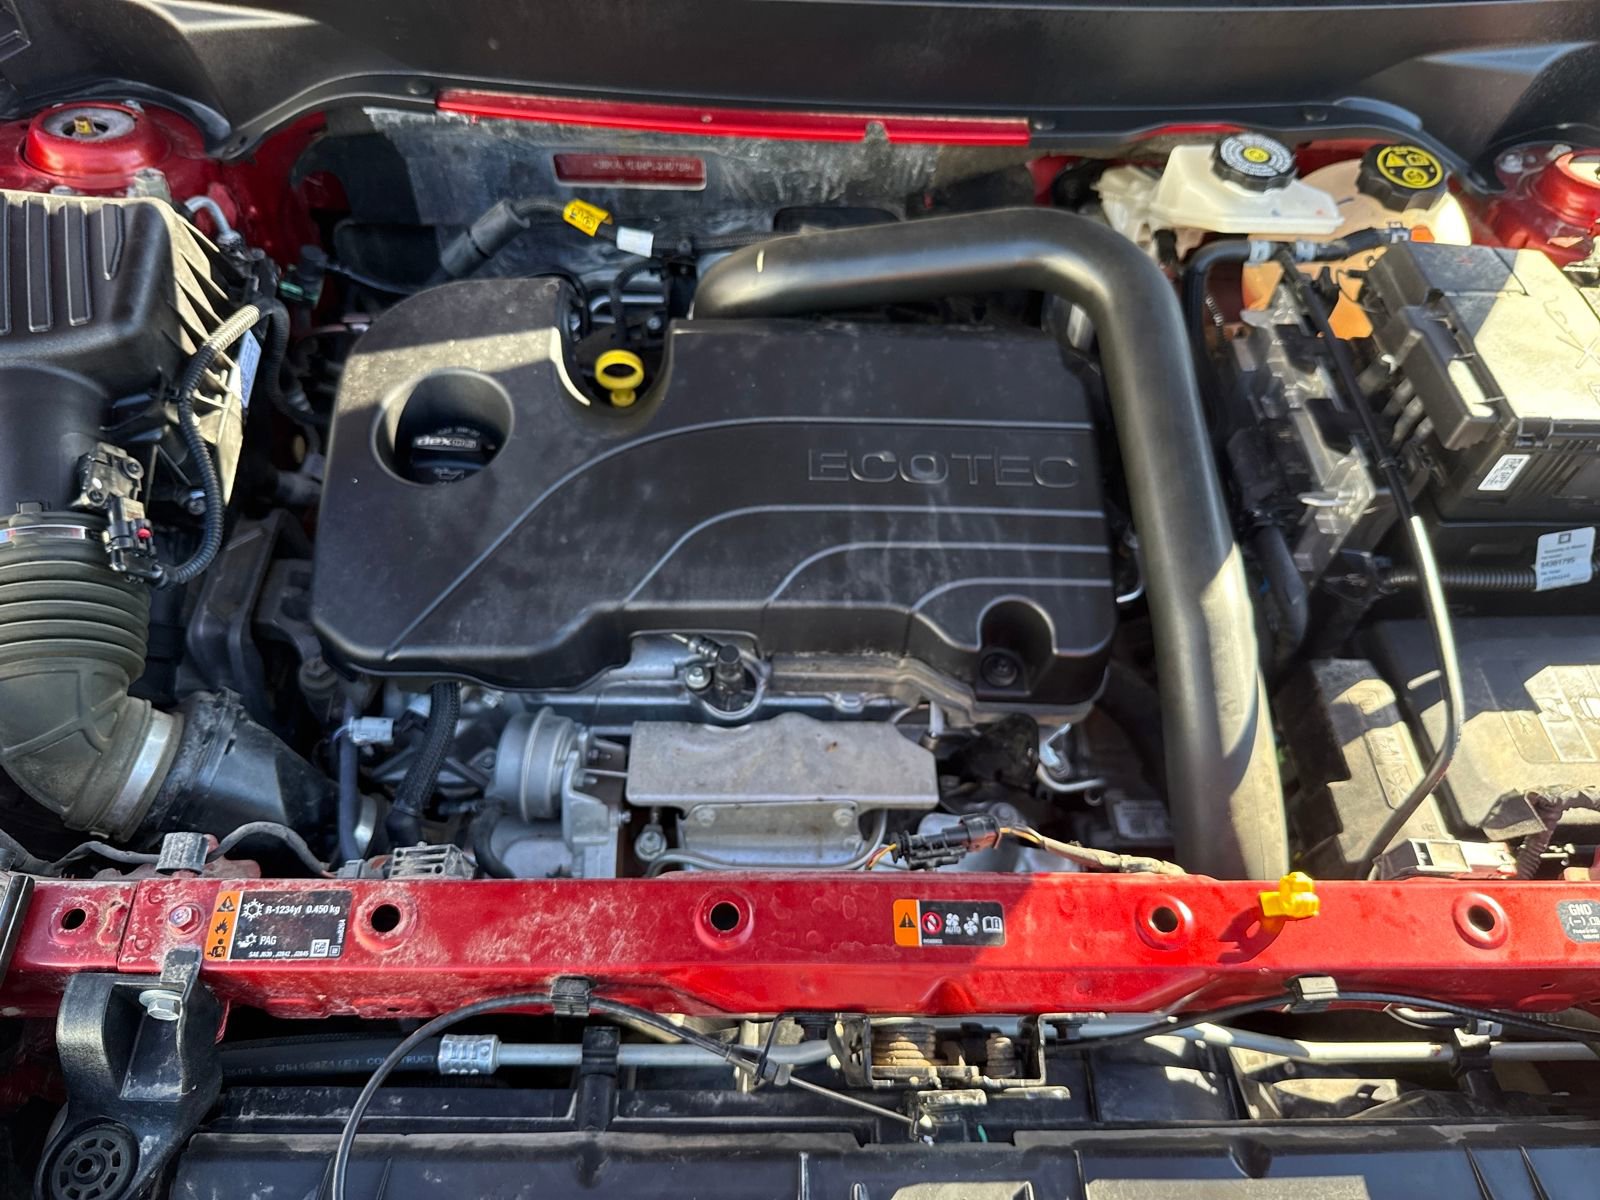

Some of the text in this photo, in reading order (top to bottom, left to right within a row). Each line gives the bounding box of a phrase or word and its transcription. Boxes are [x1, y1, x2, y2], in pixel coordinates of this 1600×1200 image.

[808, 448, 1080, 489] ECOTEC
[264, 904, 302, 916] R-1234yf
[305, 904, 341, 916] 0.450 kg
[1568, 903, 1592, 916] GND
[944, 925, 962, 935] AUTO
[259, 935, 277, 946] PAG
